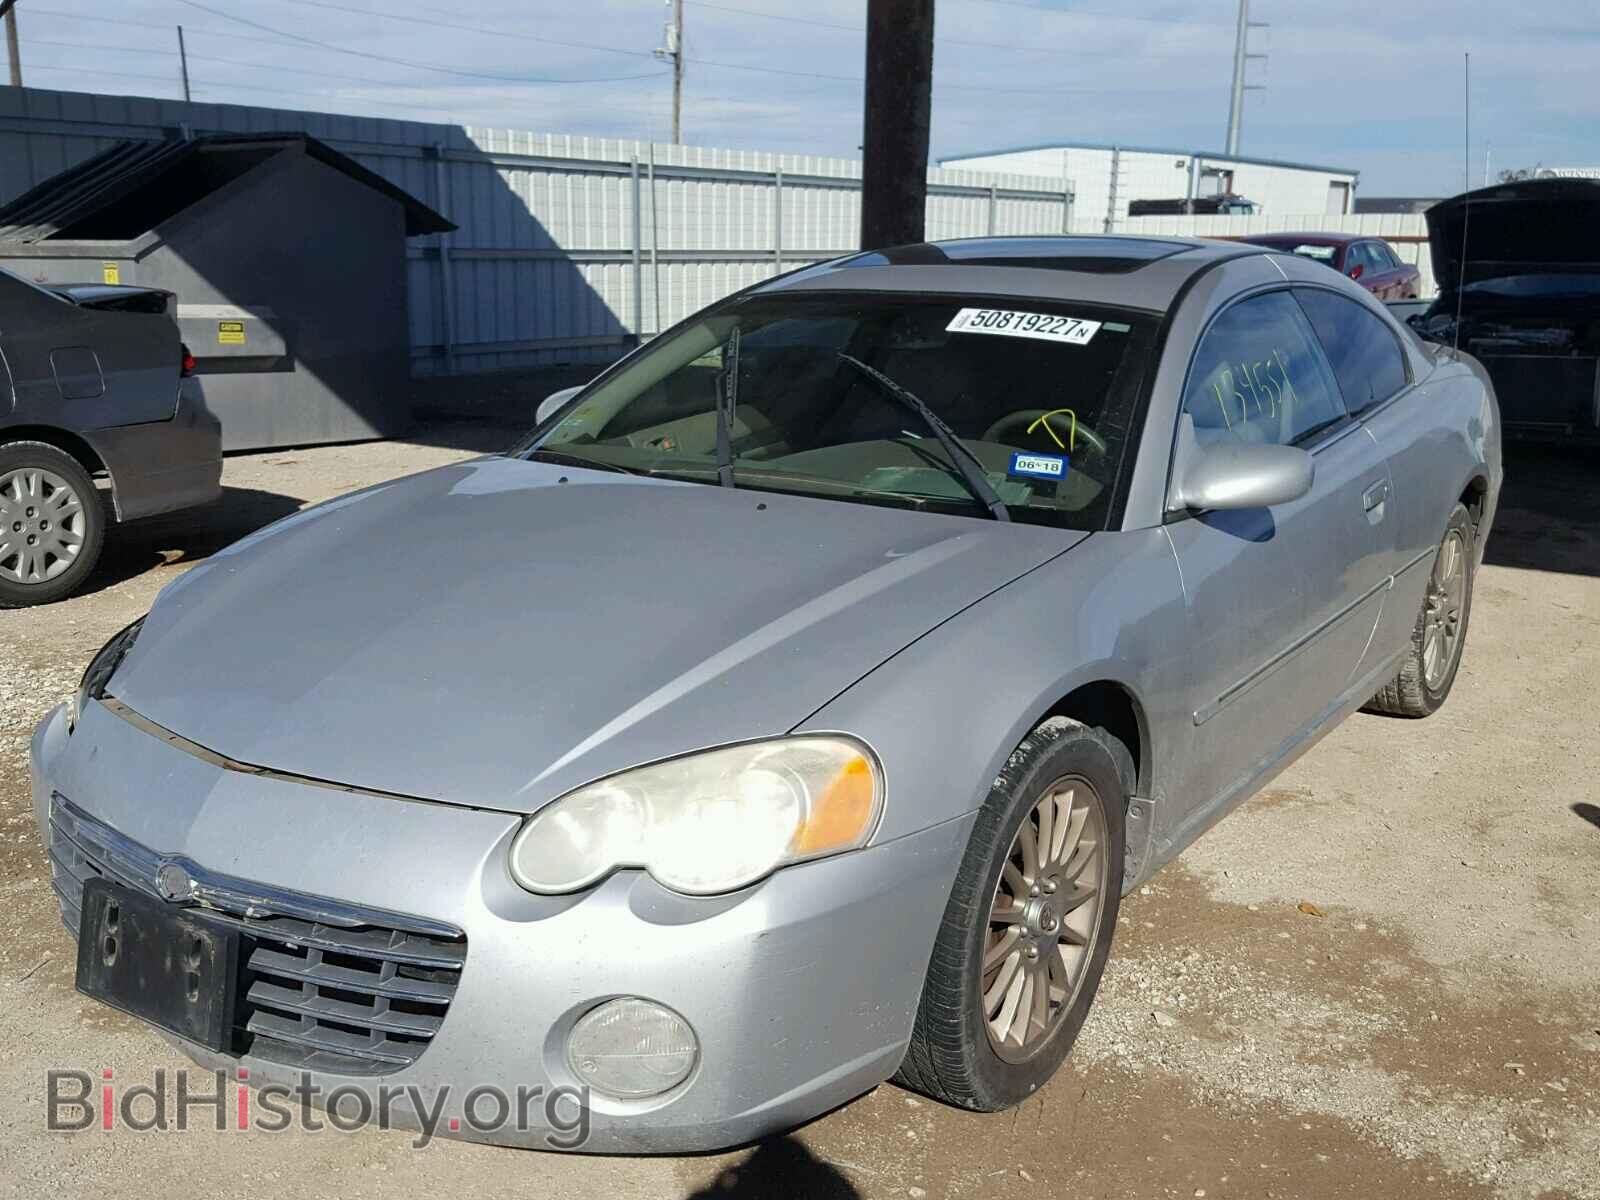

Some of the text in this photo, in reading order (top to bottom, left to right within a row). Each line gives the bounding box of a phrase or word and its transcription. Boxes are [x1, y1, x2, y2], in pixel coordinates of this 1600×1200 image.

[970, 310, 1082, 336] 50819227
[1075, 328, 1089, 338] N
[1018, 460, 1059, 472] 06 18
